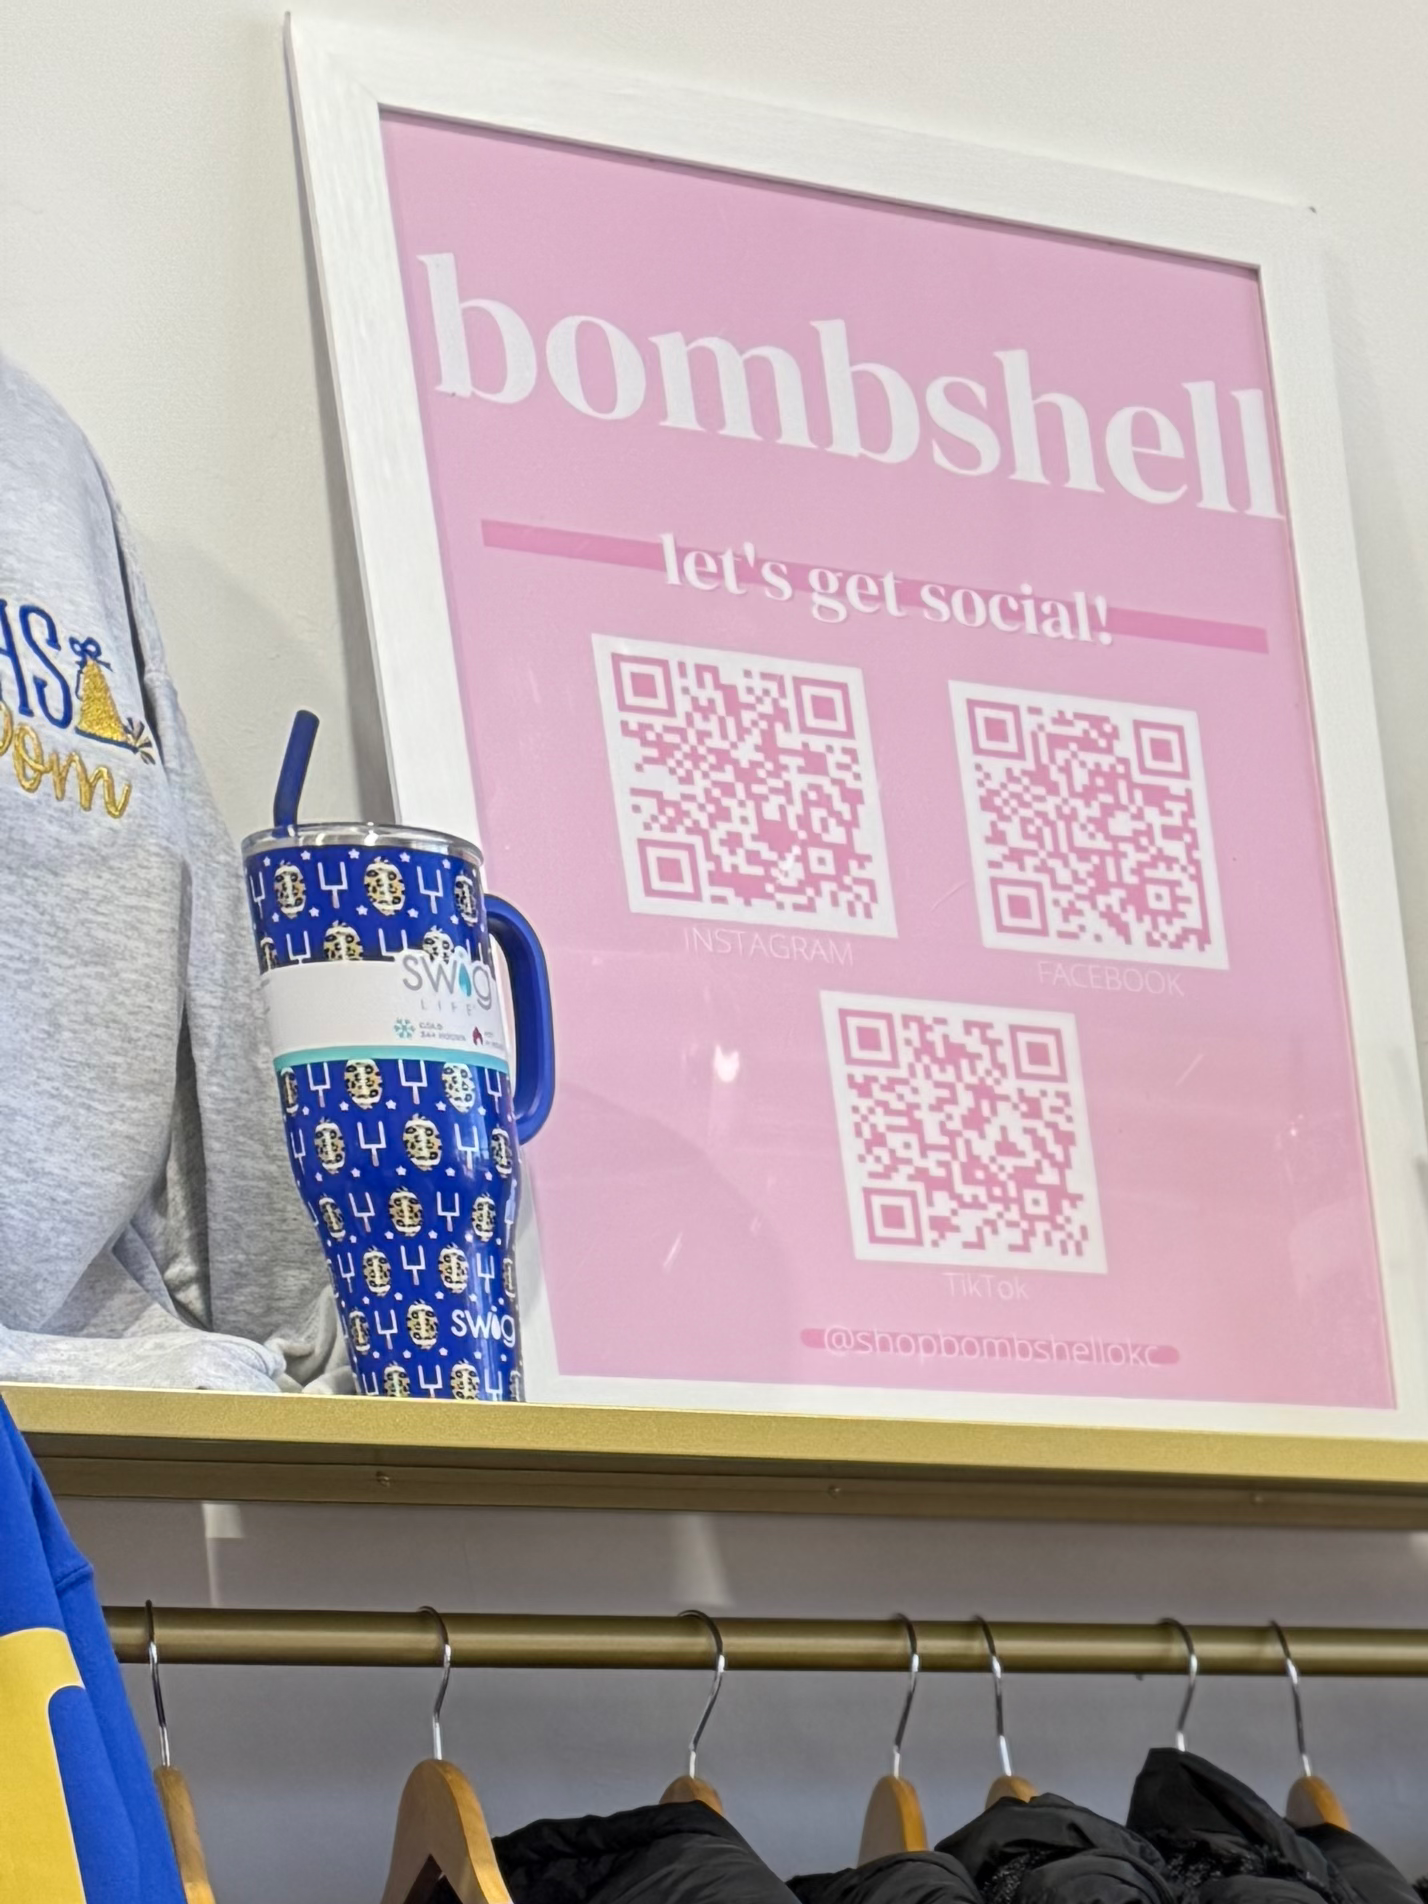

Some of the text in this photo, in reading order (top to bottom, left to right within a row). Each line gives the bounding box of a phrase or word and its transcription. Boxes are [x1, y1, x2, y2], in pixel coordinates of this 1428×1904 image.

[416, 251, 1285, 520] bombshell
[659, 532, 1113, 646] let's get social!
[683, 926, 854, 966] INSTAGRAM
[1037, 960, 1186, 997] FACEBOOK
[941, 1271, 1029, 1300] TikTok
[450, 1305, 516, 1348] swig
[823, 1325, 1161, 1368] @shopbombshellokc
